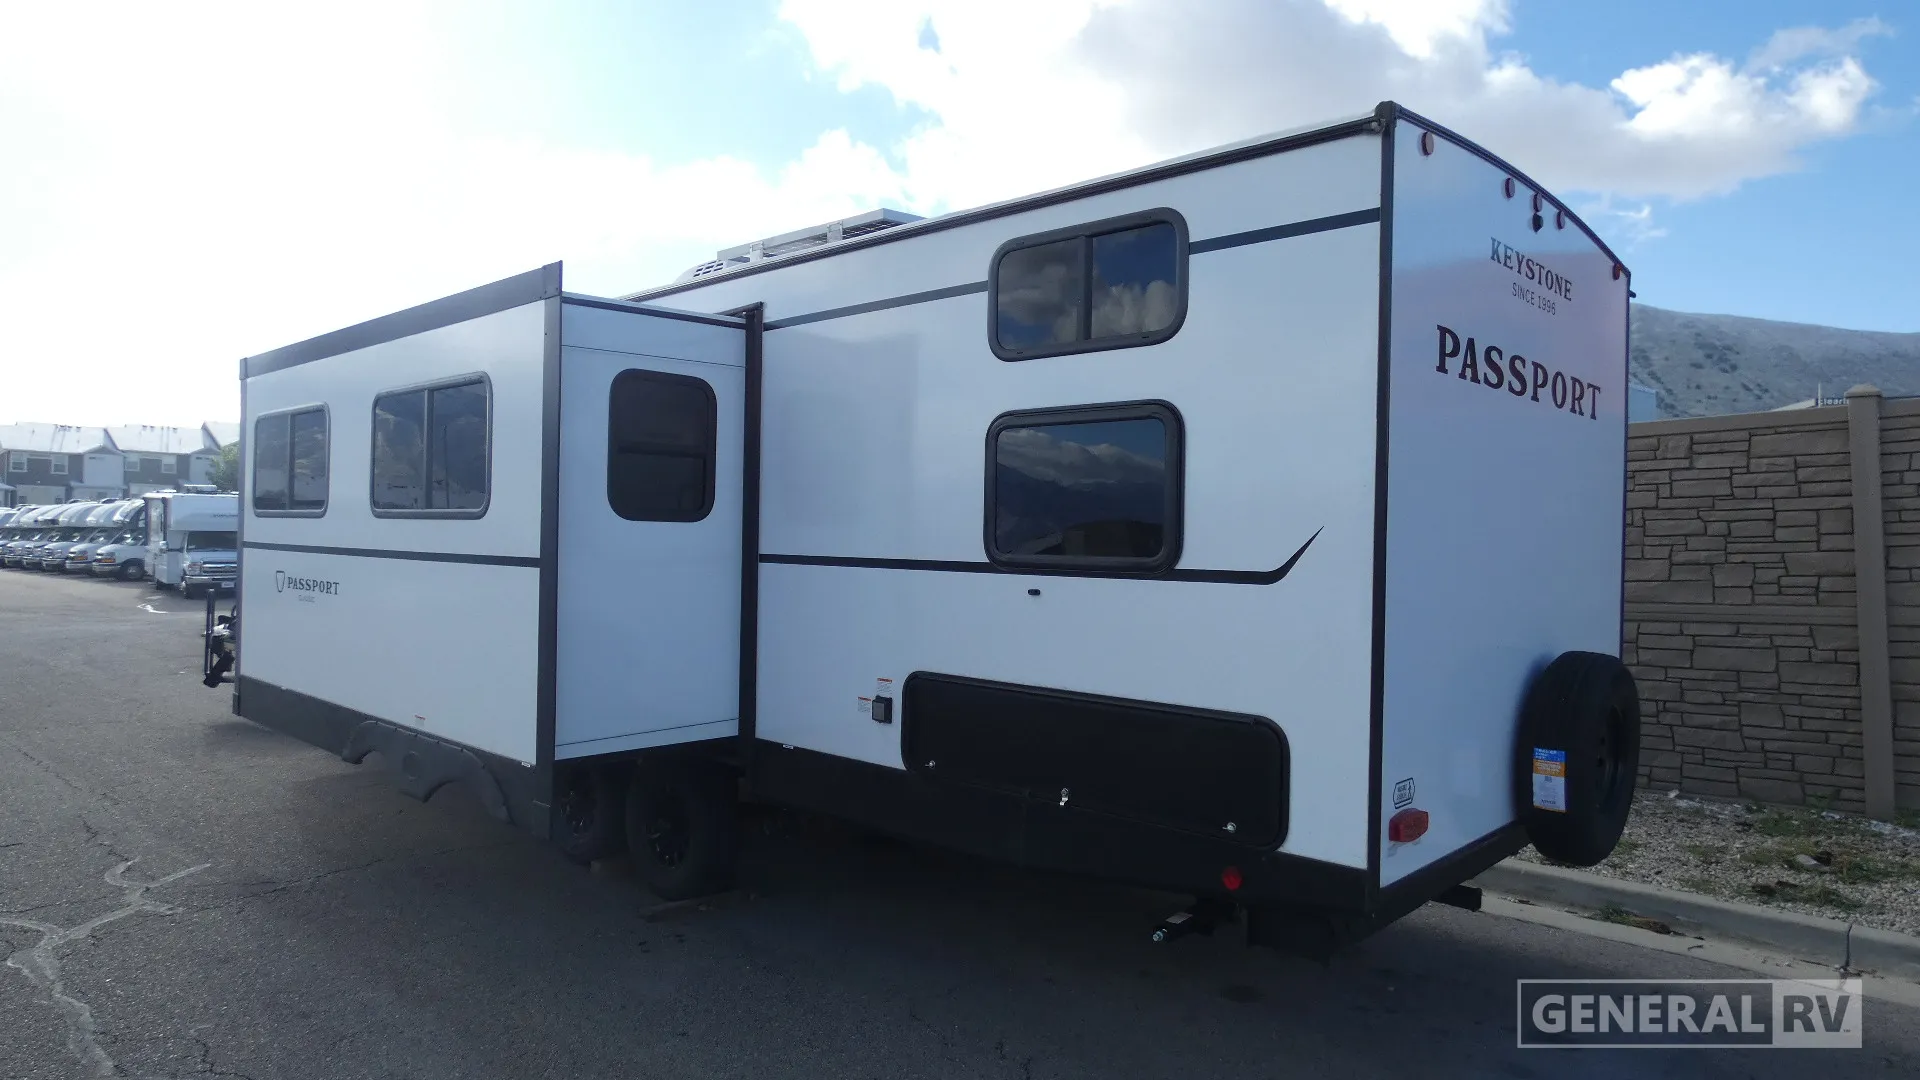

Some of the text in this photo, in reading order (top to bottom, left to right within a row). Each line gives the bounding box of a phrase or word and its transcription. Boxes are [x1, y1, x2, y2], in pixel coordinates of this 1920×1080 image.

[1490, 236, 1572, 301] KEYSTONE
[1512, 282, 1556, 316] SINCE 1996
[1435, 324, 1601, 420] PASSPORT
[287, 576, 340, 595] PASSPORT
